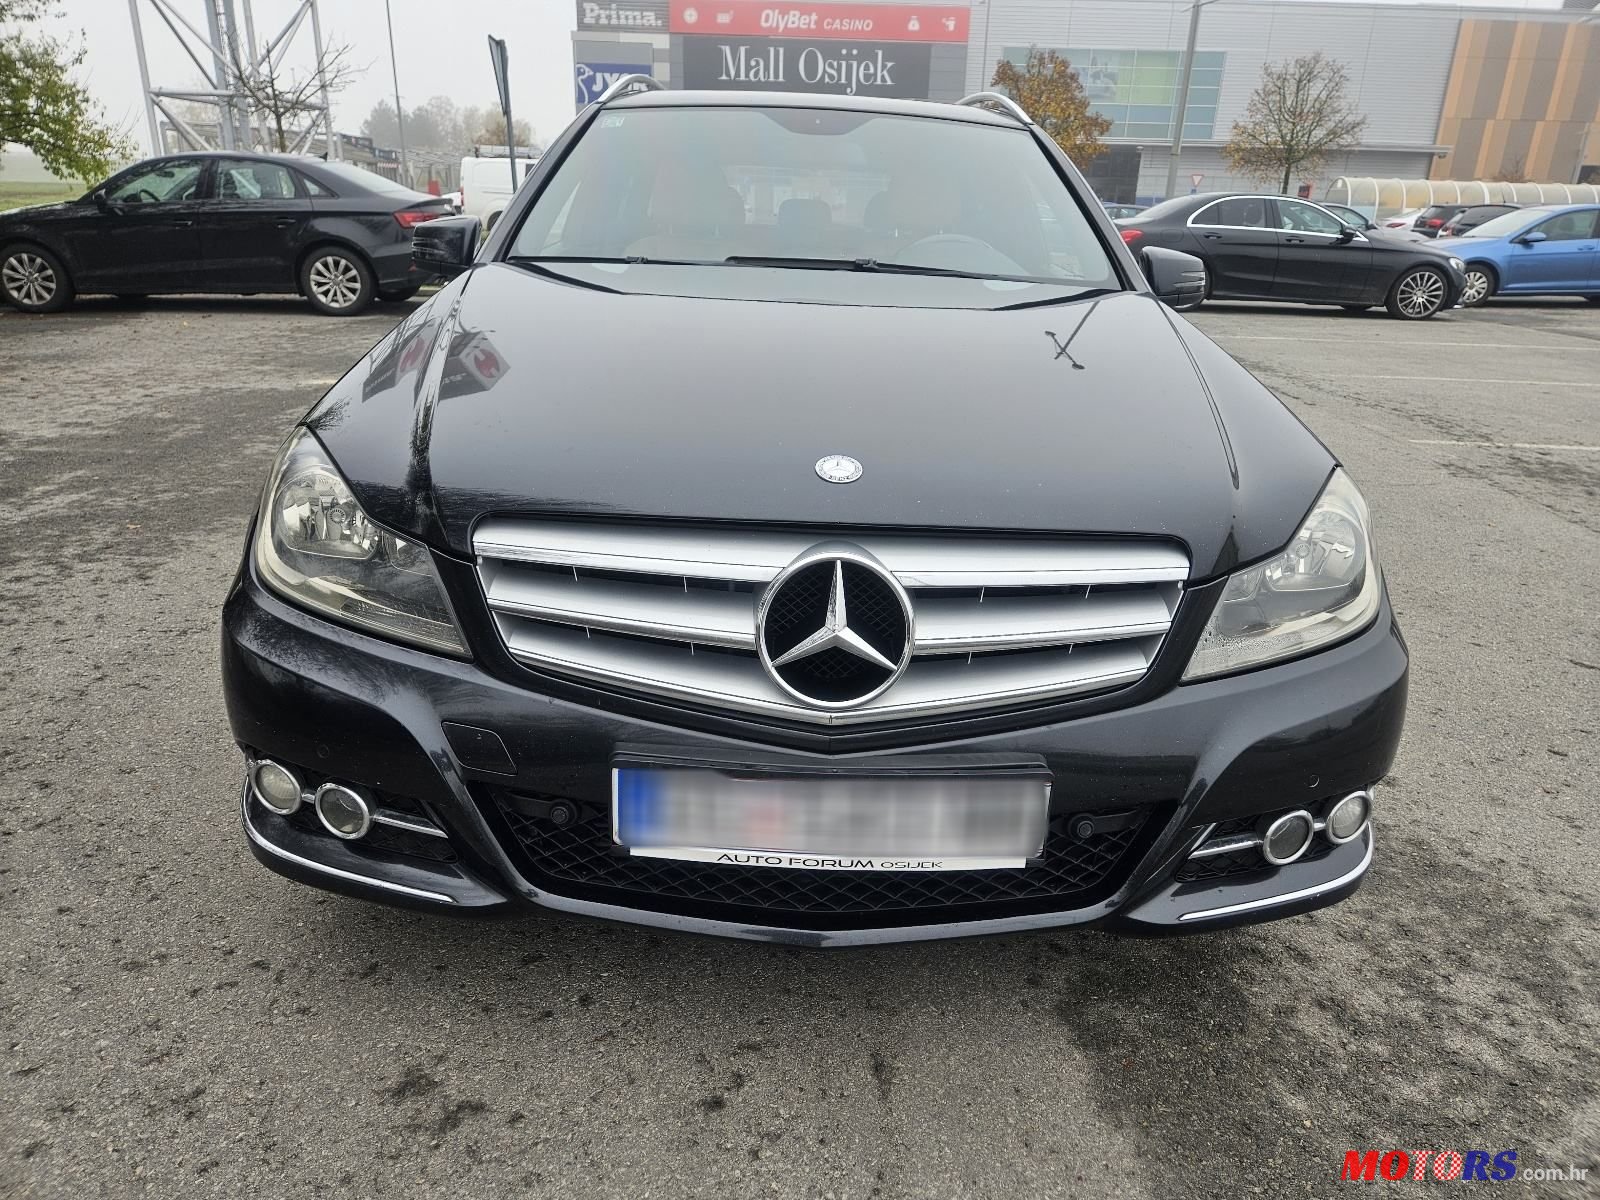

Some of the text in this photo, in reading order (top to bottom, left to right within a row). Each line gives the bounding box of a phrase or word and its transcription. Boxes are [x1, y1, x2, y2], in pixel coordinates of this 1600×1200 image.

[583, 2, 662, 26] Prima.
[760, 9, 873, 33] OlyBet CASINO
[717, 45, 896, 96] Mall Osijek
[717, 853, 943, 869] AUTO FORUM OSIJEK
